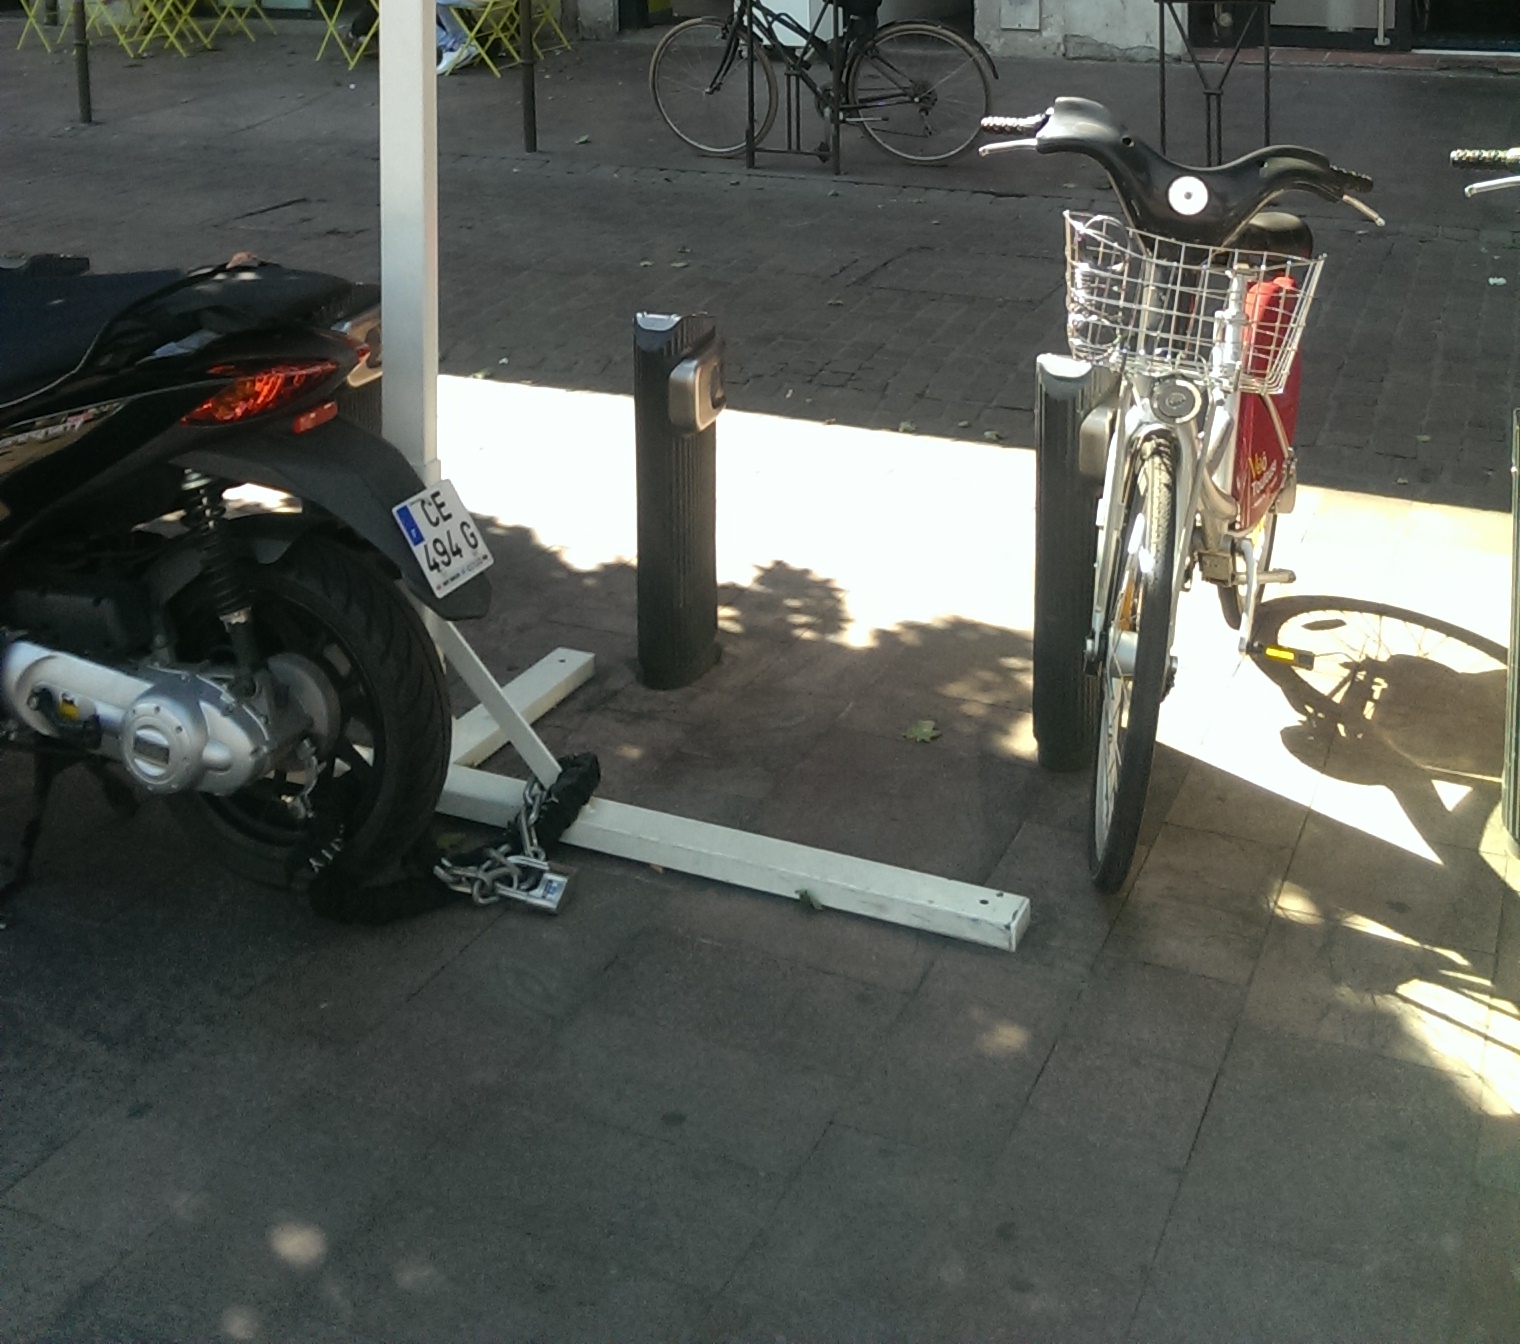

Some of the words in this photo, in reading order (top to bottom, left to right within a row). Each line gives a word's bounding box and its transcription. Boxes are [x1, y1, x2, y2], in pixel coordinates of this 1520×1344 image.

[420, 490, 453, 528] CE
[424, 529, 464, 573] 494
[460, 521, 479, 550] G
